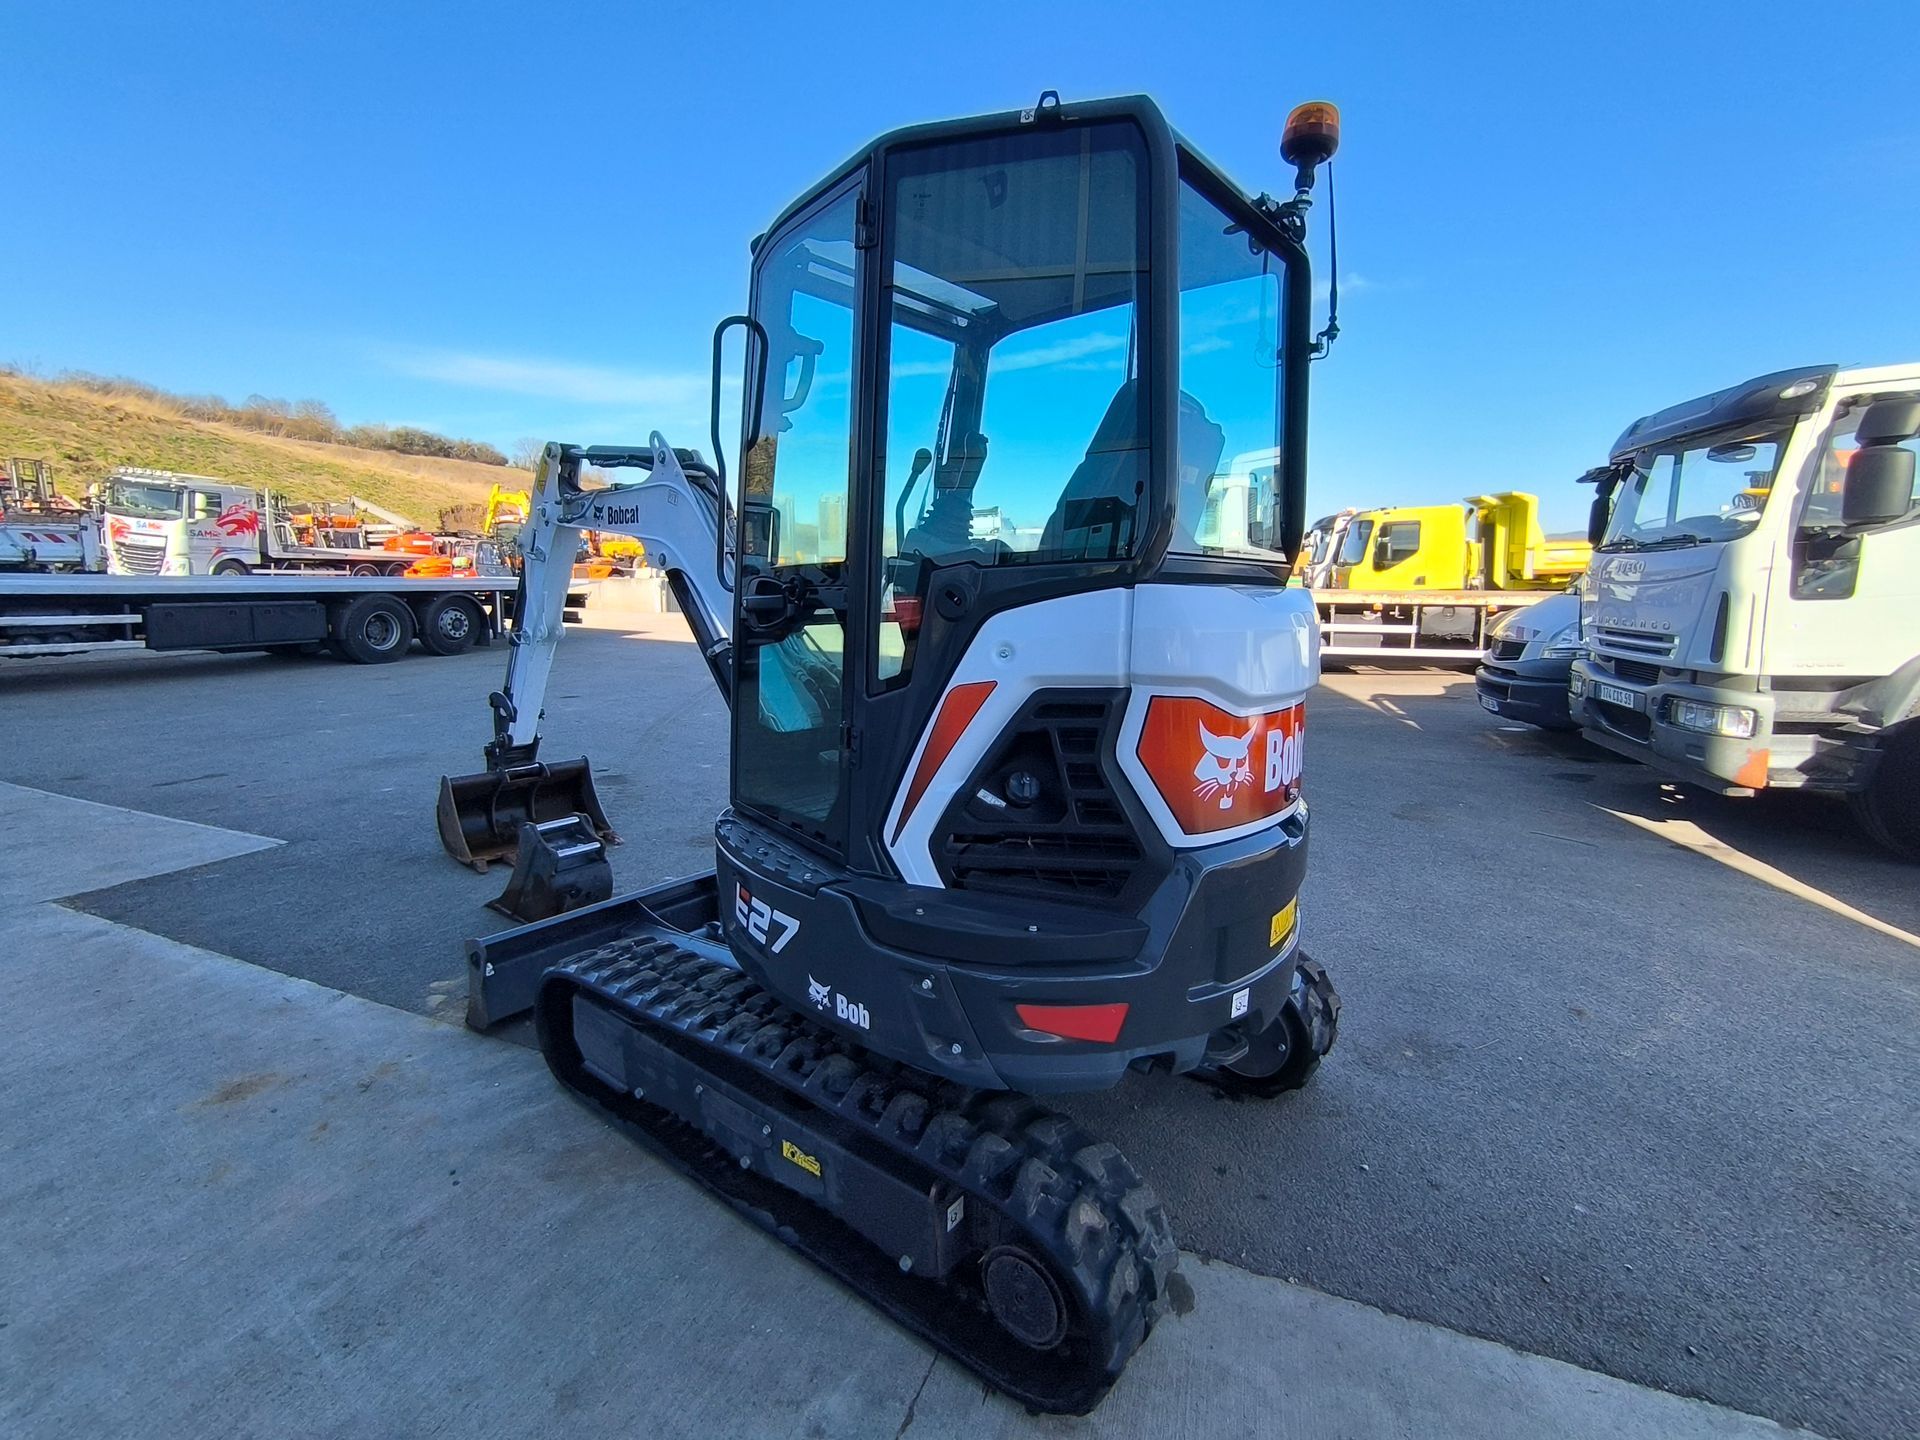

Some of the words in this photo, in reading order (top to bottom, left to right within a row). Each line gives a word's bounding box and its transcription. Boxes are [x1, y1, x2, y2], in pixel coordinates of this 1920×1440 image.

[608, 504, 640, 525] Bobcat
[1616, 559, 1647, 573] IVECO
[735, 881, 801, 954] E27
[836, 993, 871, 1030] Bob
